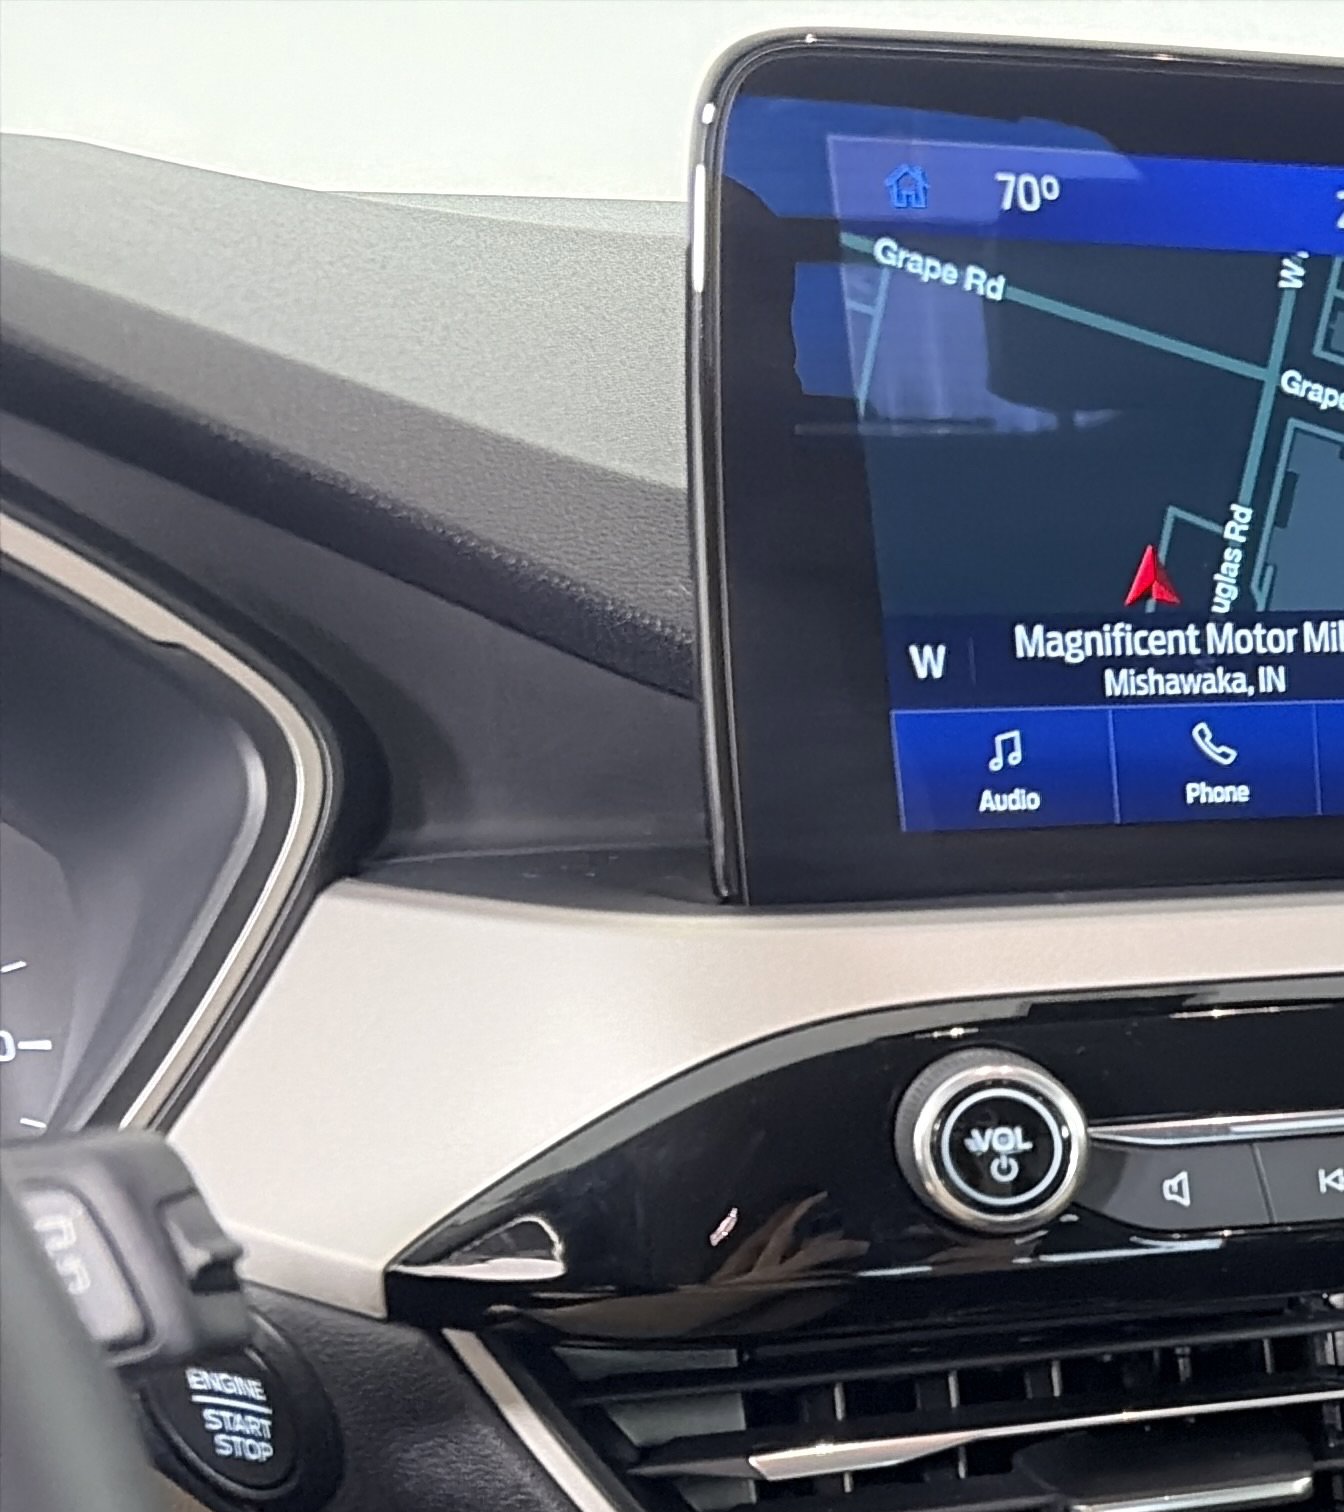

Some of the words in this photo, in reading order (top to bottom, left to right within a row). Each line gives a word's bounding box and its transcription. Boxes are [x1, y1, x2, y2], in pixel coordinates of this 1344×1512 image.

[873, 240, 958, 286] Grape
[964, 265, 1006, 302] Rd
[1223, 503, 1253, 543] Rd
[1014, 623, 1200, 663] Magnificent
[1206, 621, 1298, 655] Motor
[909, 645, 946, 679] W
[1104, 667, 1254, 698] Mishawaka,
[1258, 665, 1286, 693] IN
[979, 788, 1040, 813] Audio
[1186, 782, 1250, 804] Phone
[969, 1126, 1033, 1152] VOL
[186, 1367, 266, 1401] ENGINE
[203, 1409, 272, 1438] START
[214, 1434, 273, 1461] STOP
